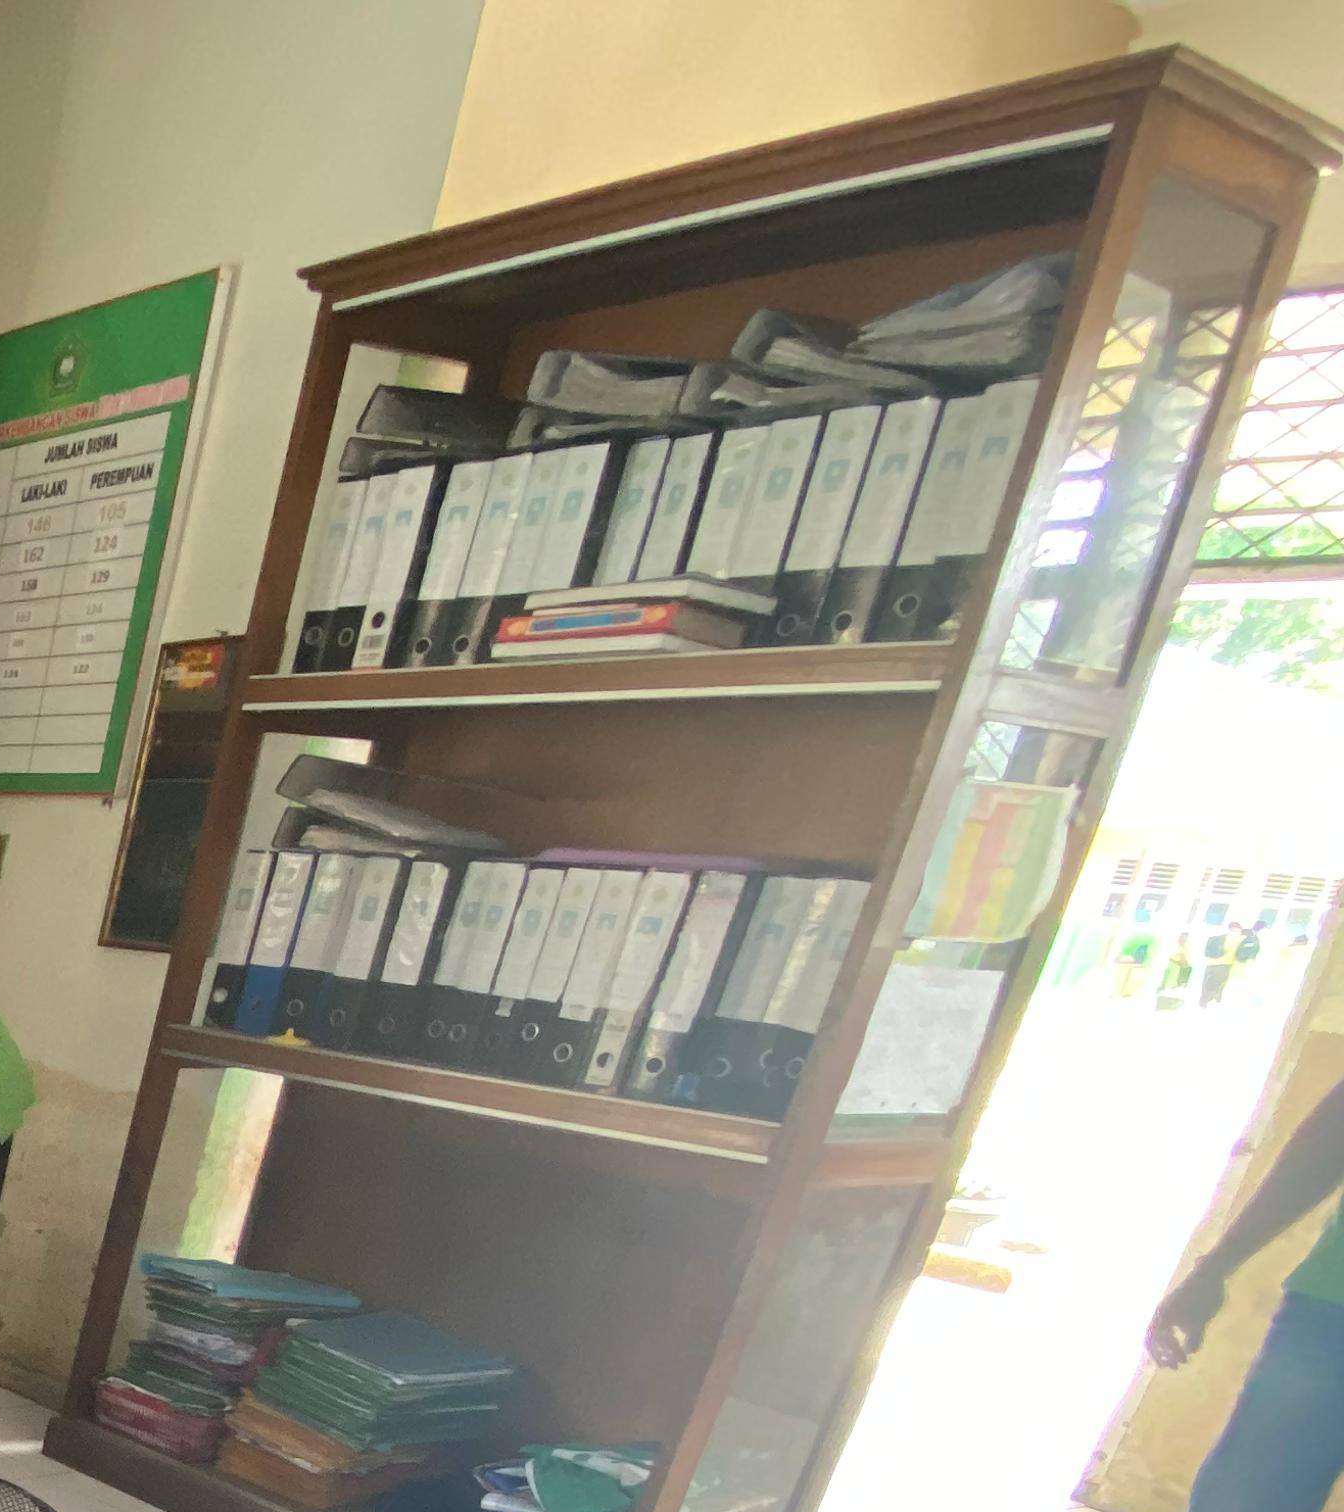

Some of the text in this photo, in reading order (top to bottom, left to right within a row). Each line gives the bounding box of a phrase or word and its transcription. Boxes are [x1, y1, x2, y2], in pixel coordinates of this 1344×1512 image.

[44, 433, 118, 463] JUMLAH SISWA
[90, 463, 155, 489] PEREMPUAN
[21, 480, 68, 503] LAKI-LAKI
